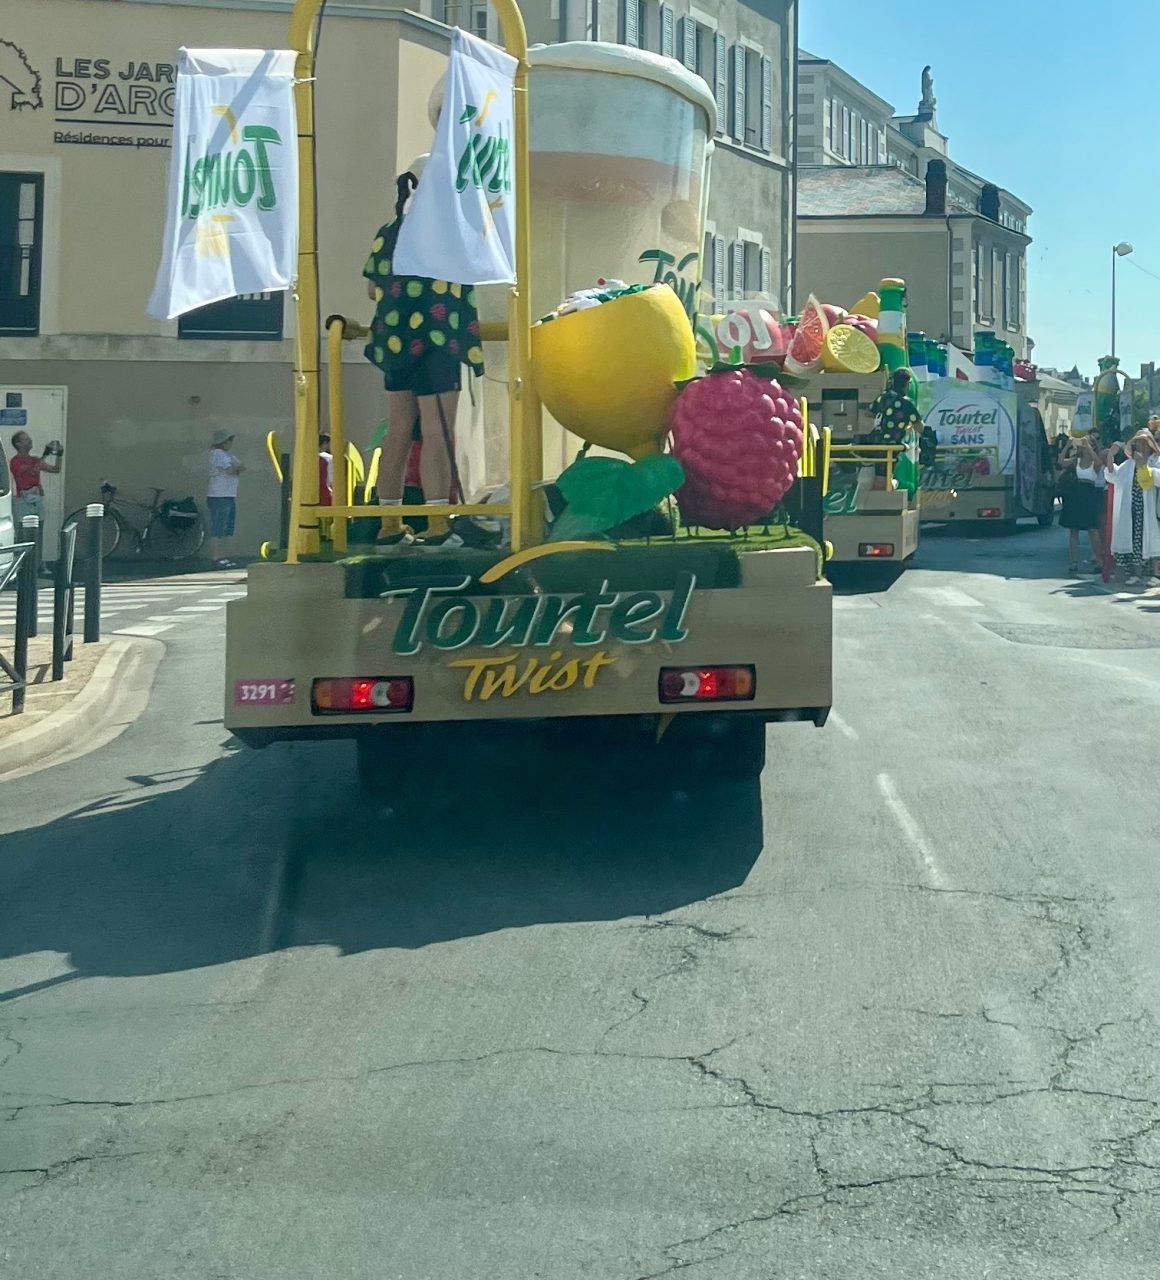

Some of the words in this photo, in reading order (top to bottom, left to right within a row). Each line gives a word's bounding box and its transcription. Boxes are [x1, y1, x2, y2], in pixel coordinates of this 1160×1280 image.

[56, 57, 111, 80] LES
[118, 62, 178, 83] JAR
[54, 131, 134, 147] Résidences
[136, 136, 170, 149] pour
[938, 408, 998, 426] Tourtel
[951, 434, 985, 445] SANS
[380, 573, 696, 655] Tourtel
[450, 651, 617, 702] Twist
[241, 684, 276, 700] 3291
